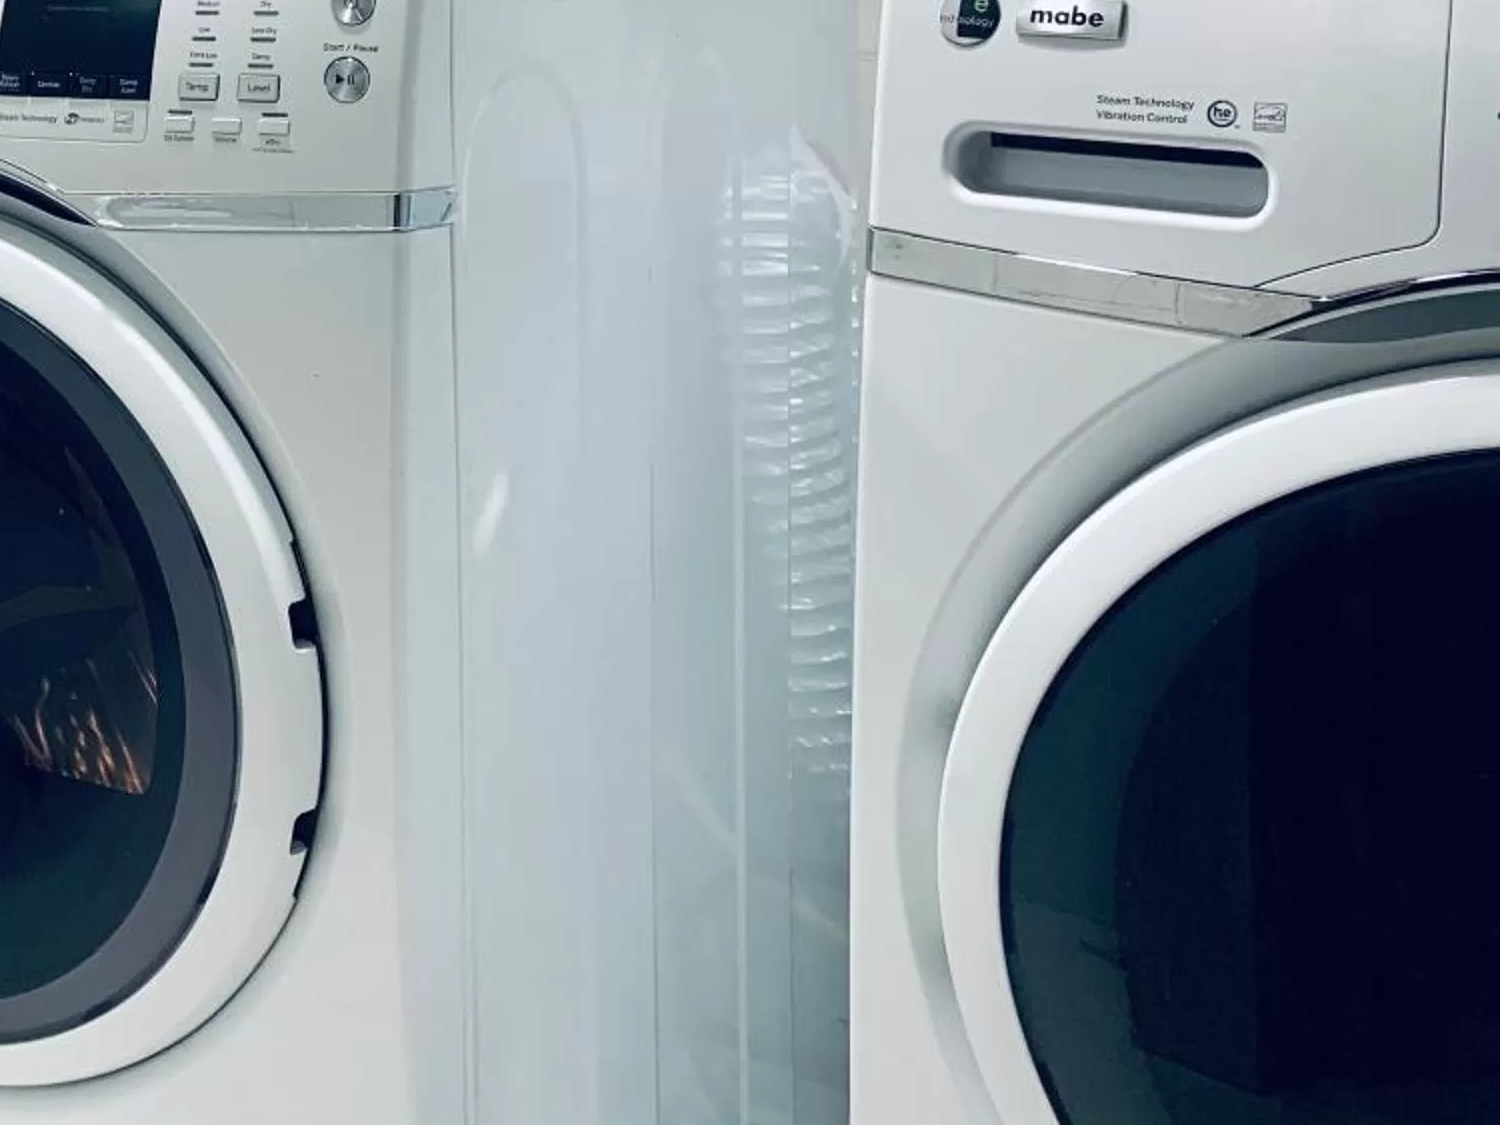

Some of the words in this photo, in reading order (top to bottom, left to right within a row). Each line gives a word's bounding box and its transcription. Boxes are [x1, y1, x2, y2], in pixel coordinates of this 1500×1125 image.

[1029, 5, 1105, 28] mabe
[323, 43, 345, 52] Start
[1096, 94, 1131, 106] Steam
[1134, 96, 1195, 111] Technology
[1096, 108, 1145, 122] Vibration
[1147, 111, 1189, 124] Control
